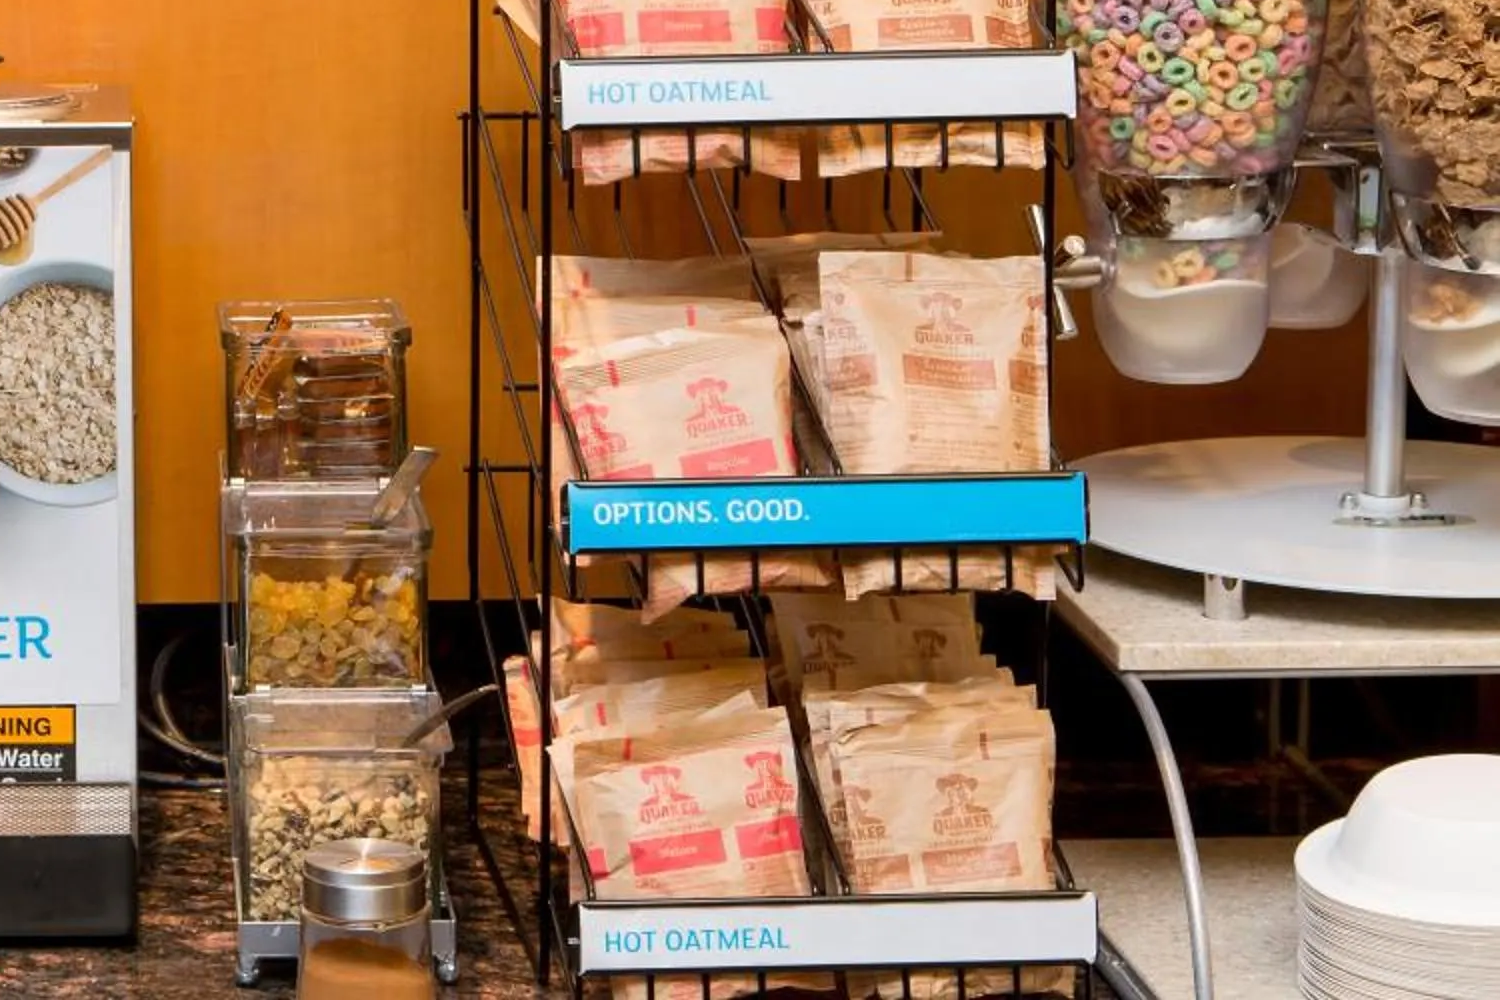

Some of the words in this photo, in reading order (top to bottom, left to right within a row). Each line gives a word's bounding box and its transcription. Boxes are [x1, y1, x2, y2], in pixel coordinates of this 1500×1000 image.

[587, 80, 641, 105] HOT
[649, 78, 774, 104] OATMEAL
[914, 329, 974, 345] QUAKER
[686, 412, 747, 440] QUAKER
[593, 500, 719, 527] OPTIONS.
[726, 498, 811, 523] GOOD.
[639, 801, 703, 825] QUAKER
[932, 813, 994, 836] QUAKER
[603, 930, 658, 954] HOT
[665, 925, 791, 952] OATMEAL
